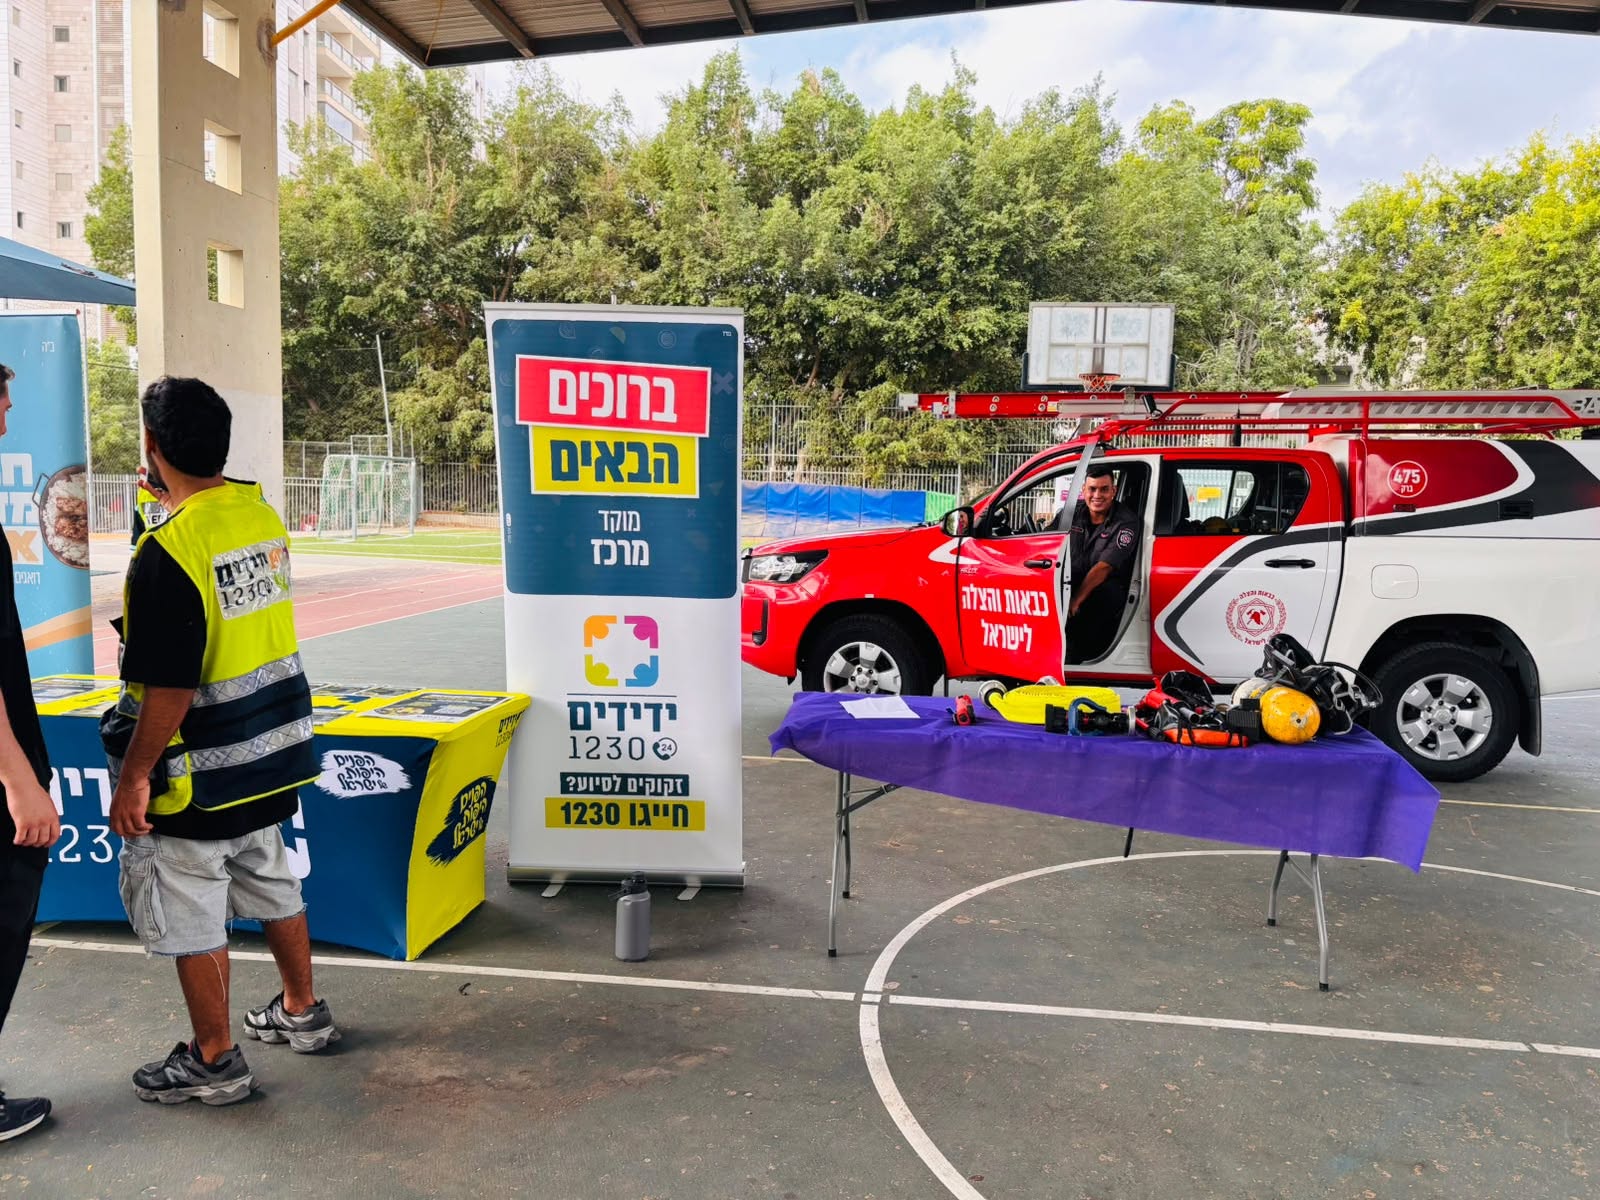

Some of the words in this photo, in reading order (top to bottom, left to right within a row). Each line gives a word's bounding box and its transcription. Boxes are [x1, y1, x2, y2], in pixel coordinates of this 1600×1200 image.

[549, 368, 678, 423] ברוכים
[550, 439, 680, 485] הבאים
[1393, 469, 1421, 484] 475
[598, 508, 641, 533] מוקד
[590, 538, 650, 567] מרכז
[221, 579, 267, 610] 1230
[961, 582, 1003, 613] והצלה
[1004, 588, 1050, 617] כבאות
[981, 618, 1033, 653] לישראל
[567, 701, 678, 732] ידידים
[333, 754, 376, 769] הפנים
[569, 735, 646, 761] 1230
[337, 772, 377, 791] ישראל
[566, 774, 622, 792] לסיוע?
[627, 777, 684, 796] זקוקים
[560, 801, 621, 826] 1230
[629, 802, 690, 828] חייגו
[48, 823, 125, 864] 23
